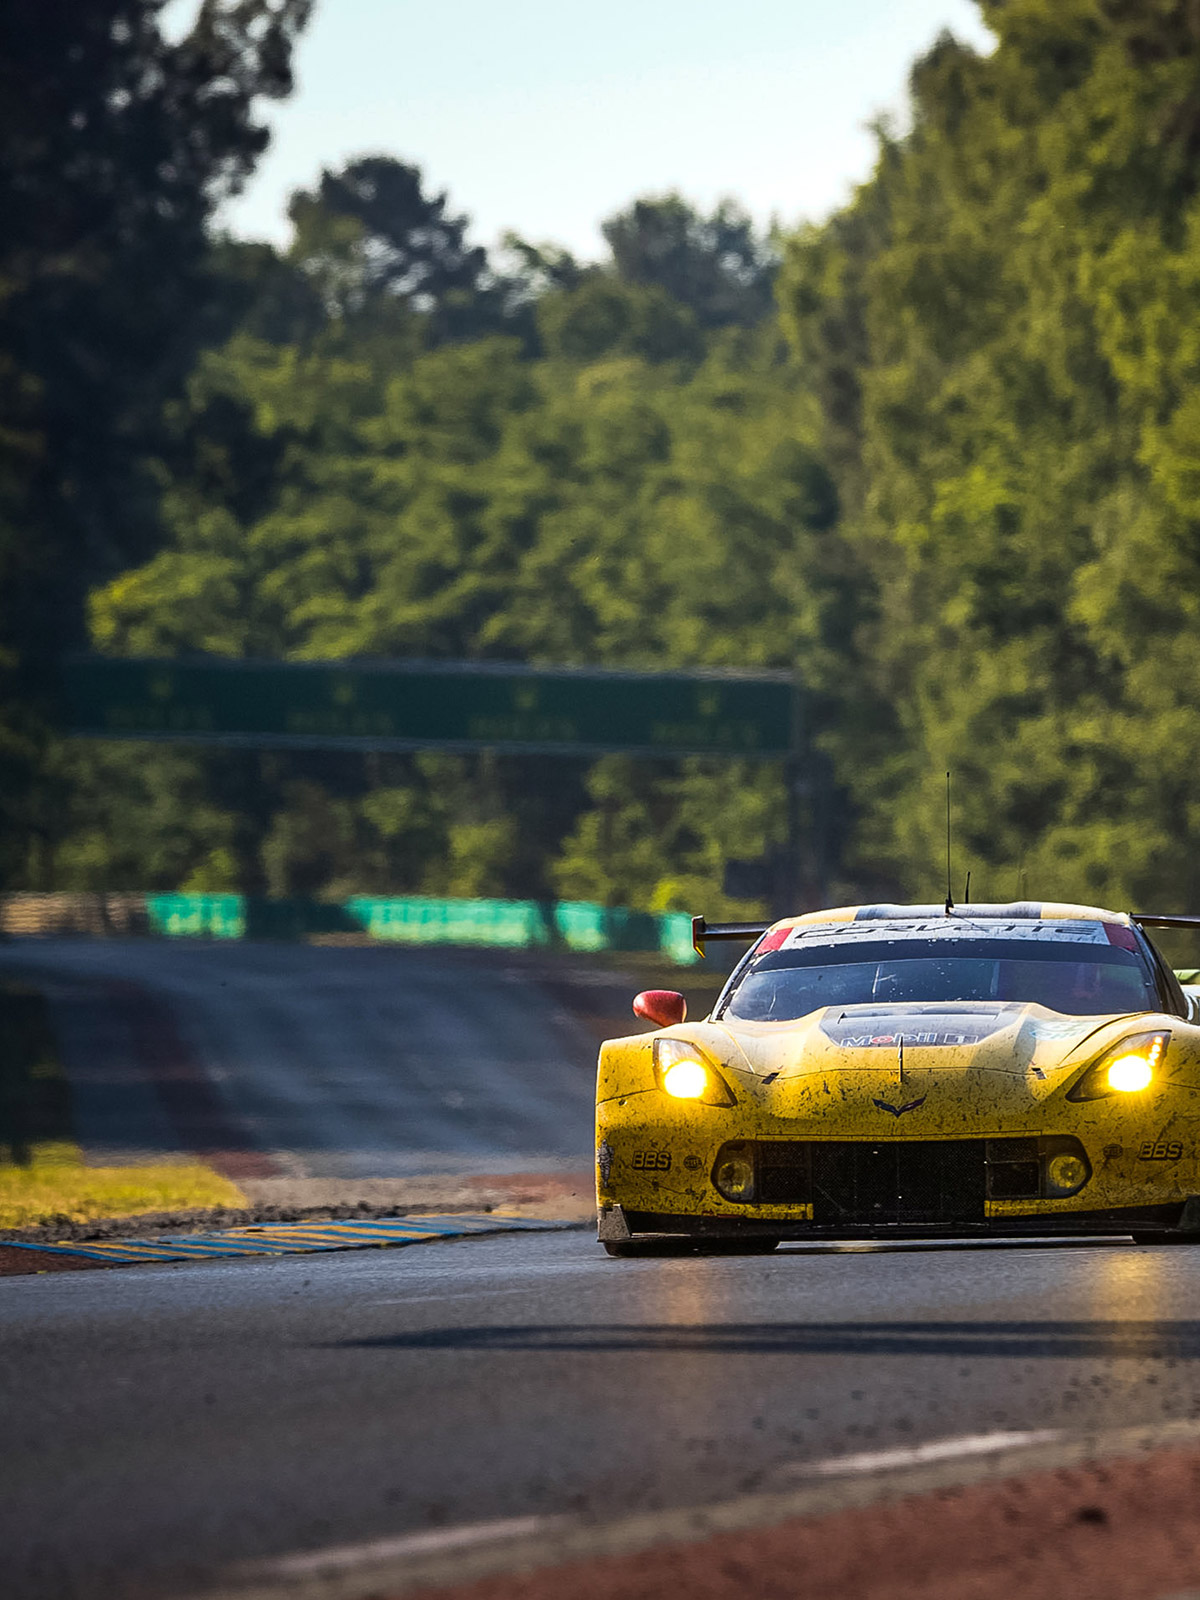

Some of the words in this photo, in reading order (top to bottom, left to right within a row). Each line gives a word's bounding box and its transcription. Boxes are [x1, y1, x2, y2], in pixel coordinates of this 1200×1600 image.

[794, 924, 1098, 939] CORVETTE
[631, 1150, 673, 1172] BBS
[1138, 1141, 1183, 1161] BBS
